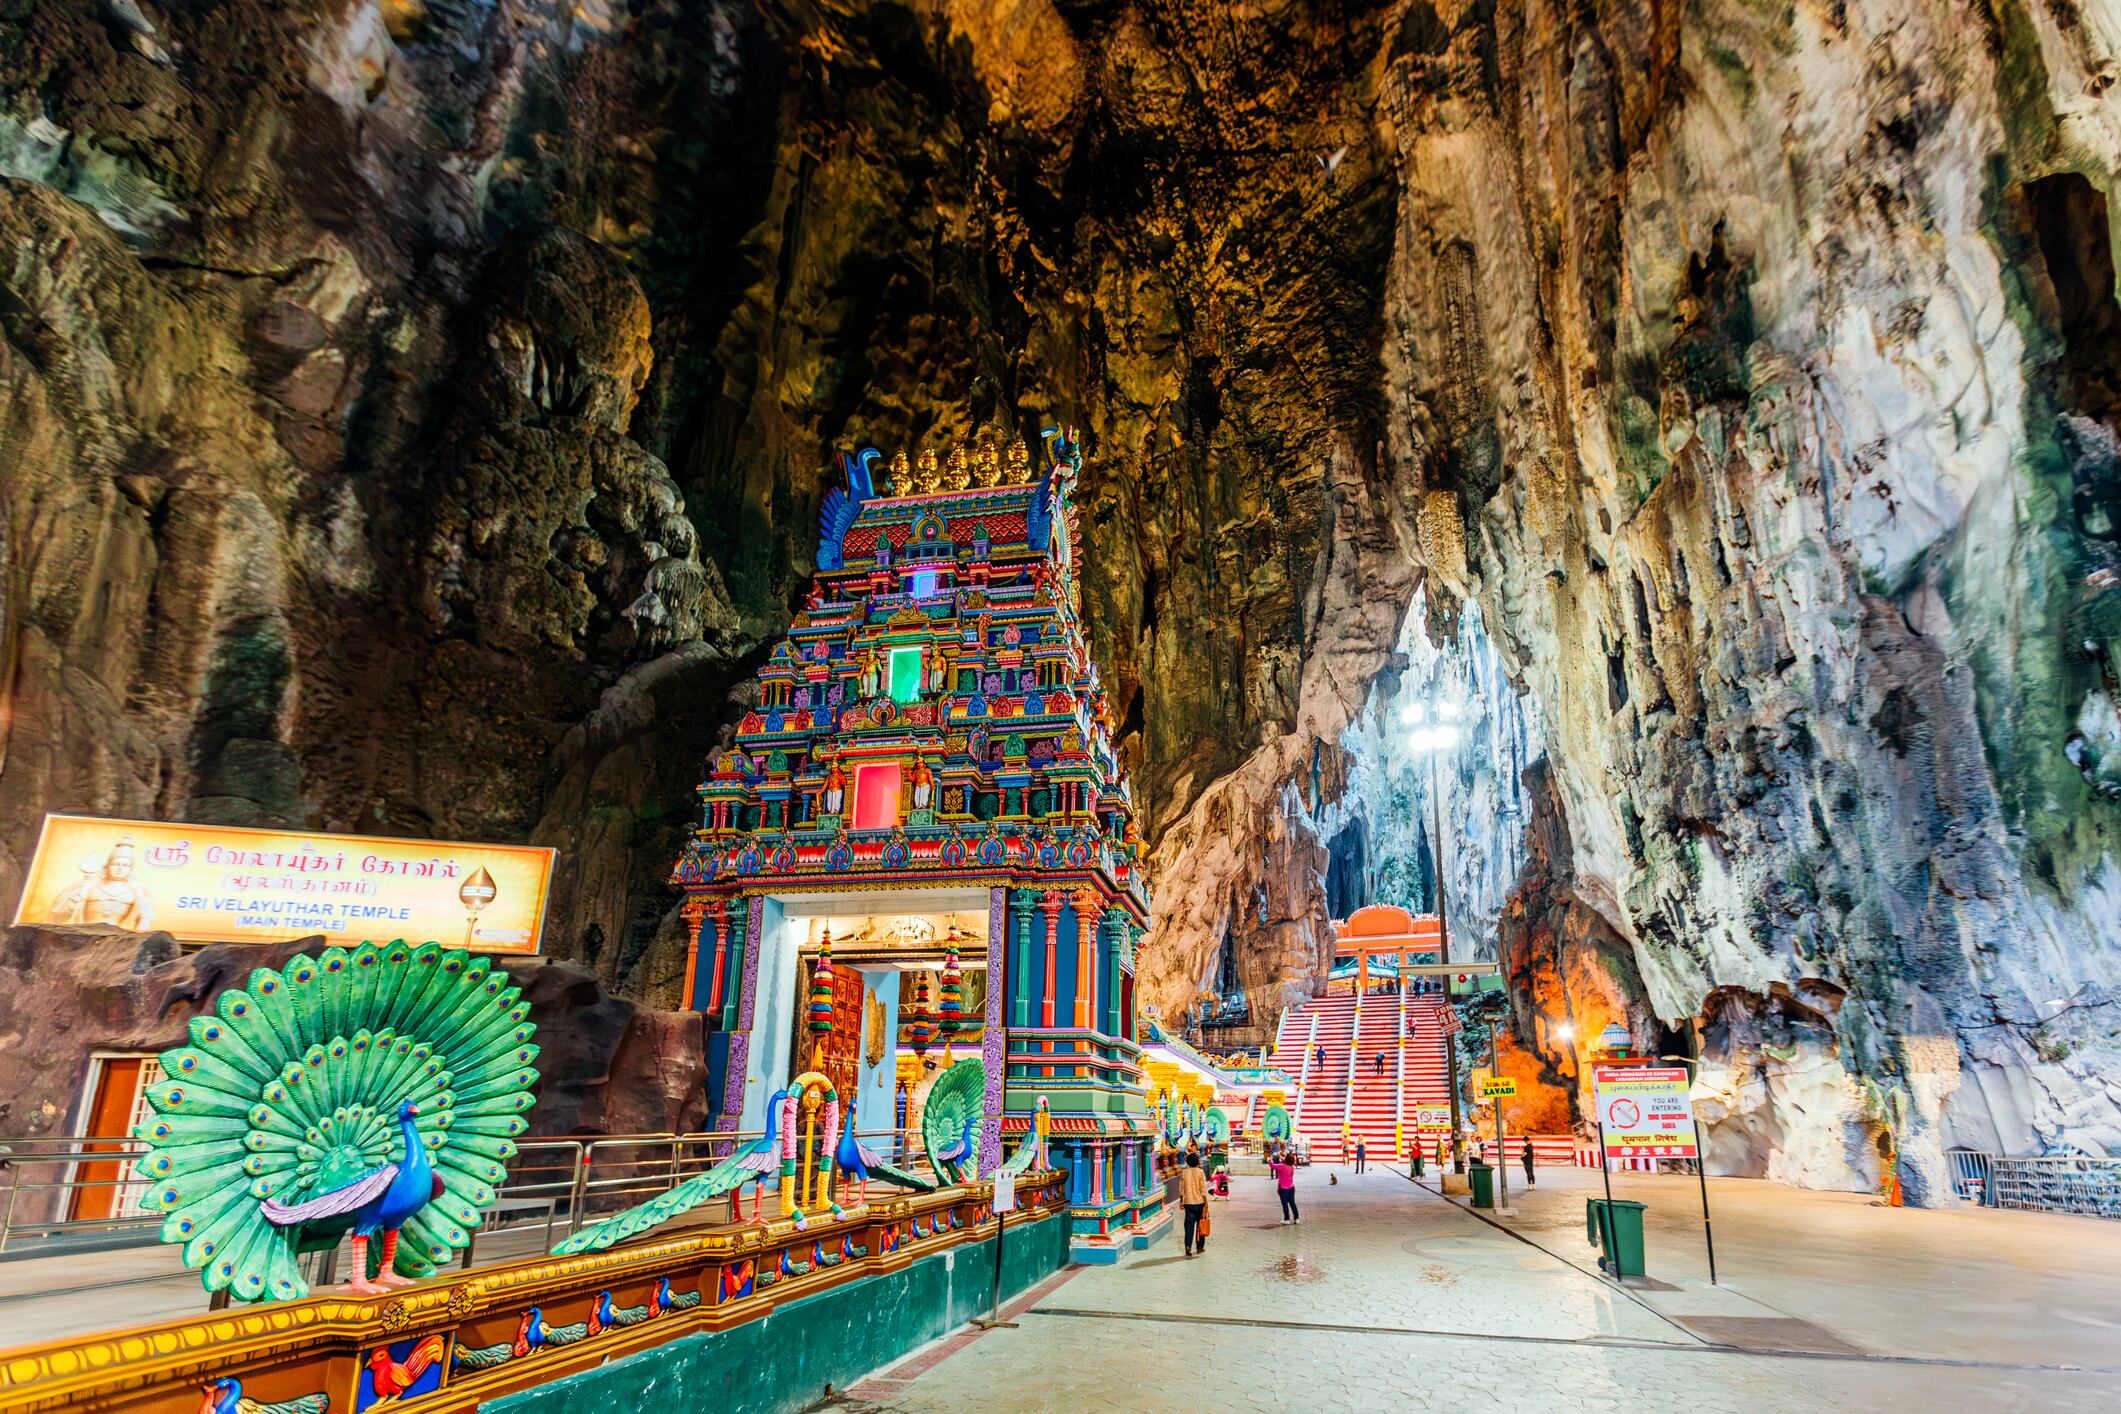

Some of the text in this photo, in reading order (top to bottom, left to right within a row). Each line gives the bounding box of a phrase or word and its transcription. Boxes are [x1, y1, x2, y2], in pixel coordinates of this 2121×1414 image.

[362, 855, 460, 878] கோவில்
[176, 896, 411, 920] SRI VELAYUTHAR TEMPLE
[236, 915, 347, 931] (MAIN TEMPLE)
[1439, 1010, 1458, 1024] 4A
[1483, 1087, 1515, 1096] KAVADI
